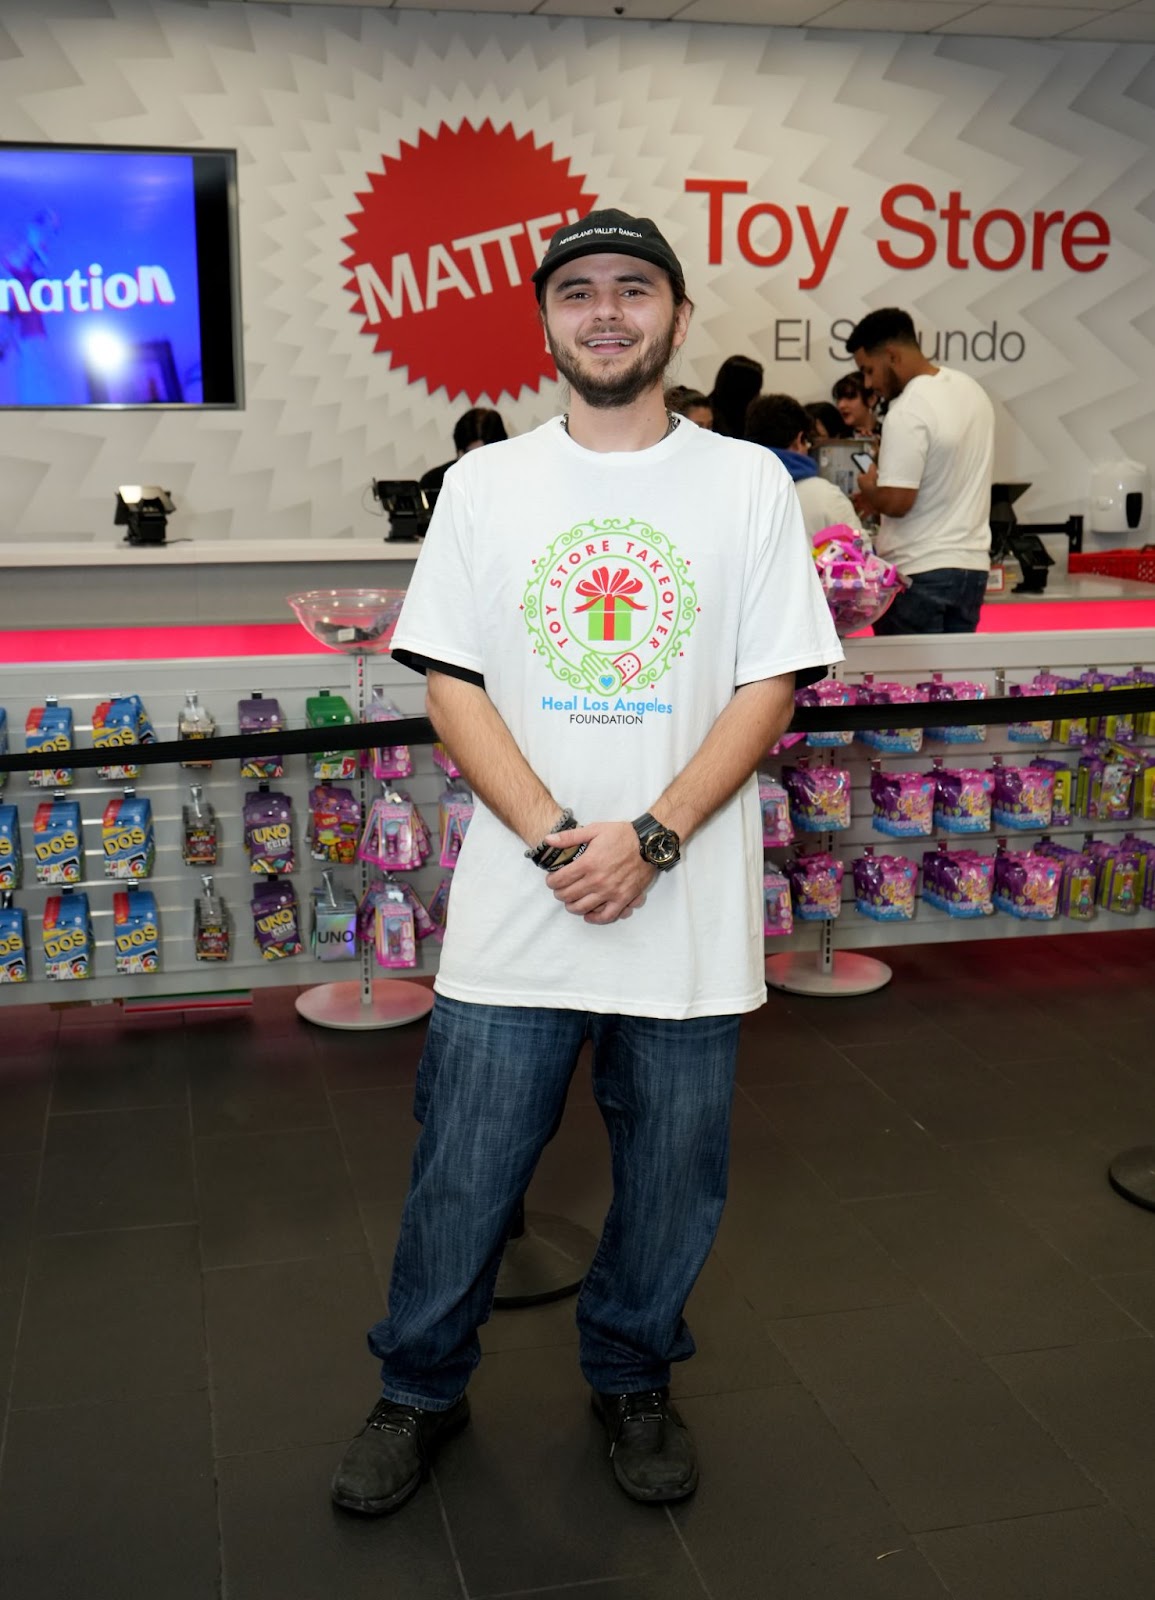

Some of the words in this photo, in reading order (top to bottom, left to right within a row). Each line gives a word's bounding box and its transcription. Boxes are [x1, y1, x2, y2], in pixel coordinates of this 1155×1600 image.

[559, 228, 593, 245] NEVERLAND
[594, 227, 618, 235] VALLEY
[618, 227, 642, 238] RANCH
[685, 179, 849, 290] Toy
[877, 183, 1111, 273] Store
[774, 319, 811, 361] El
[829, 319, 1026, 362] Sundo
[550, 540, 610, 589] STORE
[626, 541, 675, 649] TAKEOVER
[546, 605, 569, 649] TOY
[542, 696, 577, 710] Heal
[583, 697, 609, 711] Los
[613, 698, 673, 715] Angeles
[569, 714, 643, 725] FOUNDATION
[34, 830, 78, 861] DOS
[103, 827, 146, 857] DOS
[251, 823, 291, 845] UNO
[257, 909, 294, 932] UNO
[44, 929, 87, 958] DOS
[116, 924, 158, 952] DOS
[317, 930, 355, 944] UNO
